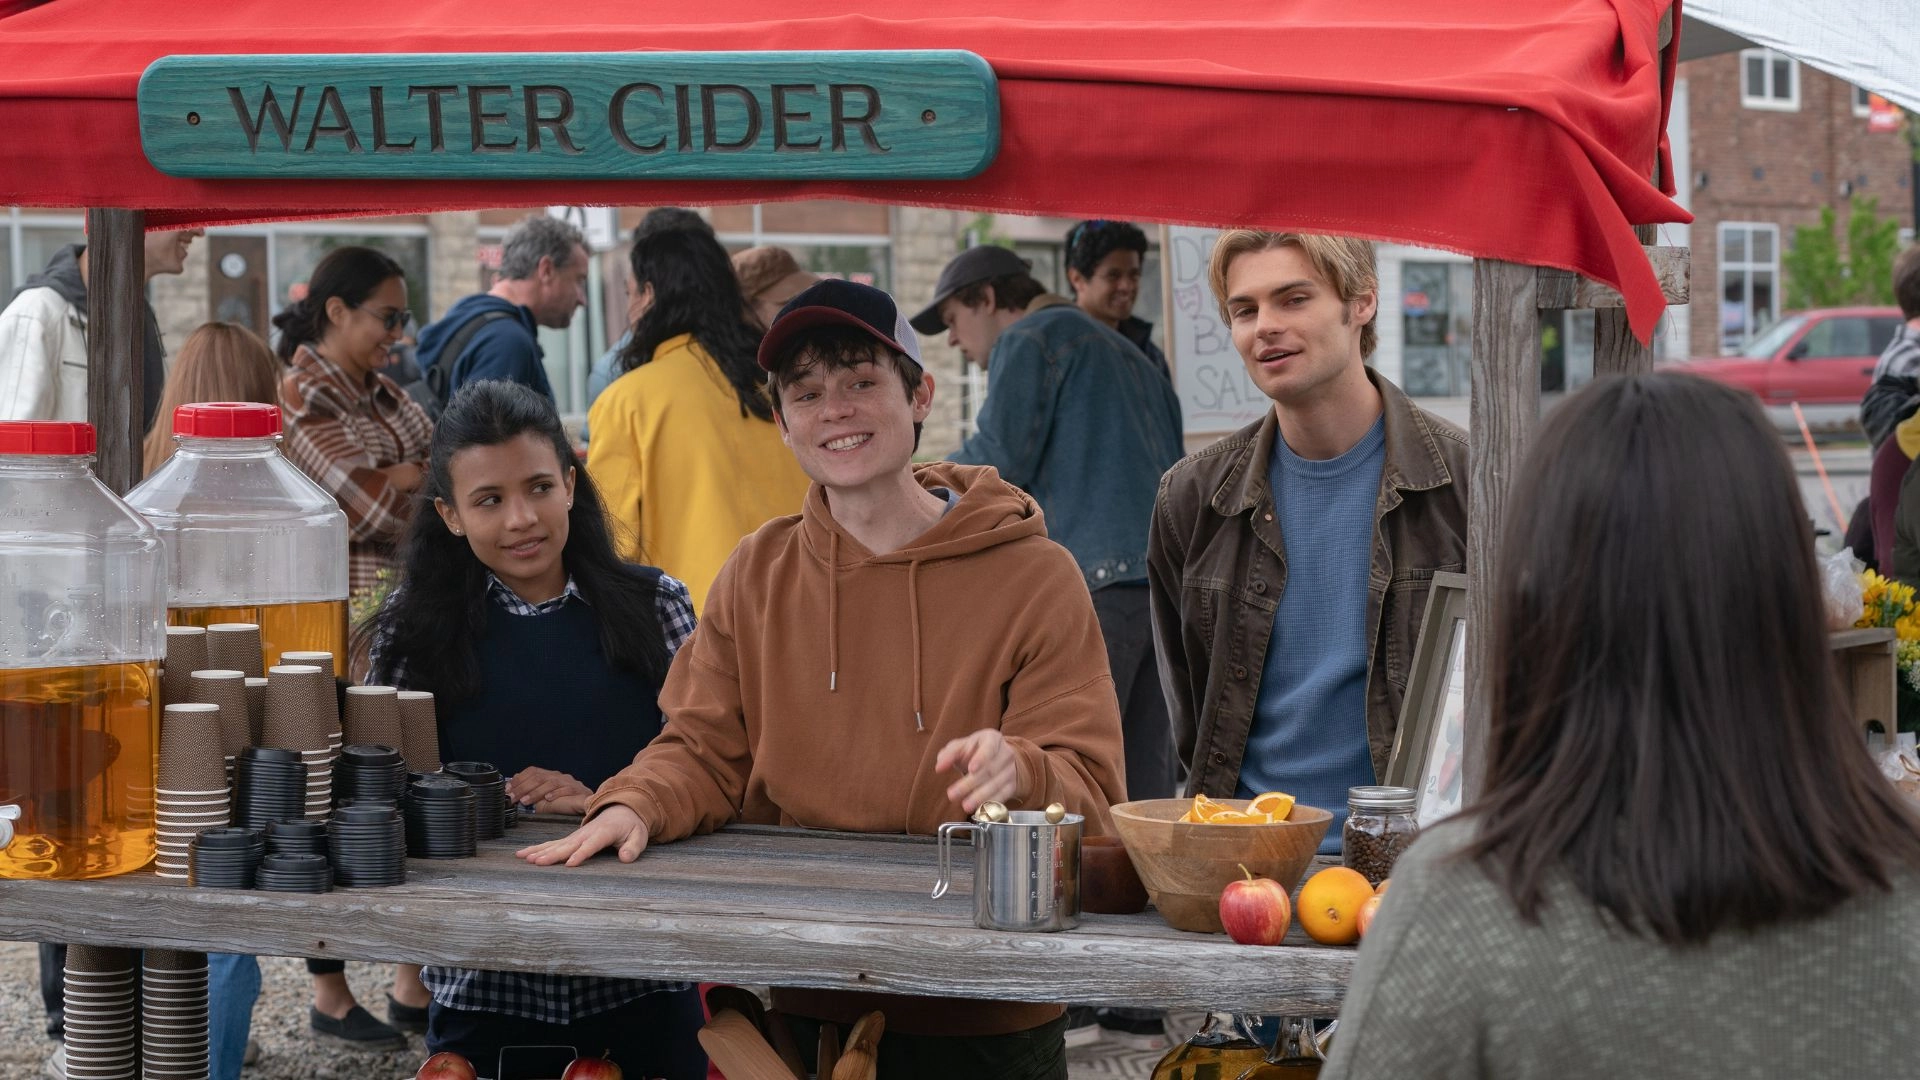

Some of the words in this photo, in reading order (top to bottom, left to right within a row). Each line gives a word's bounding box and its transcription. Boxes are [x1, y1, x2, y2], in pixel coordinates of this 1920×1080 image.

[226, 81, 586, 155] WALTER
[608, 81, 892, 156] CIDER
[1193, 364, 1264, 411] SAL
